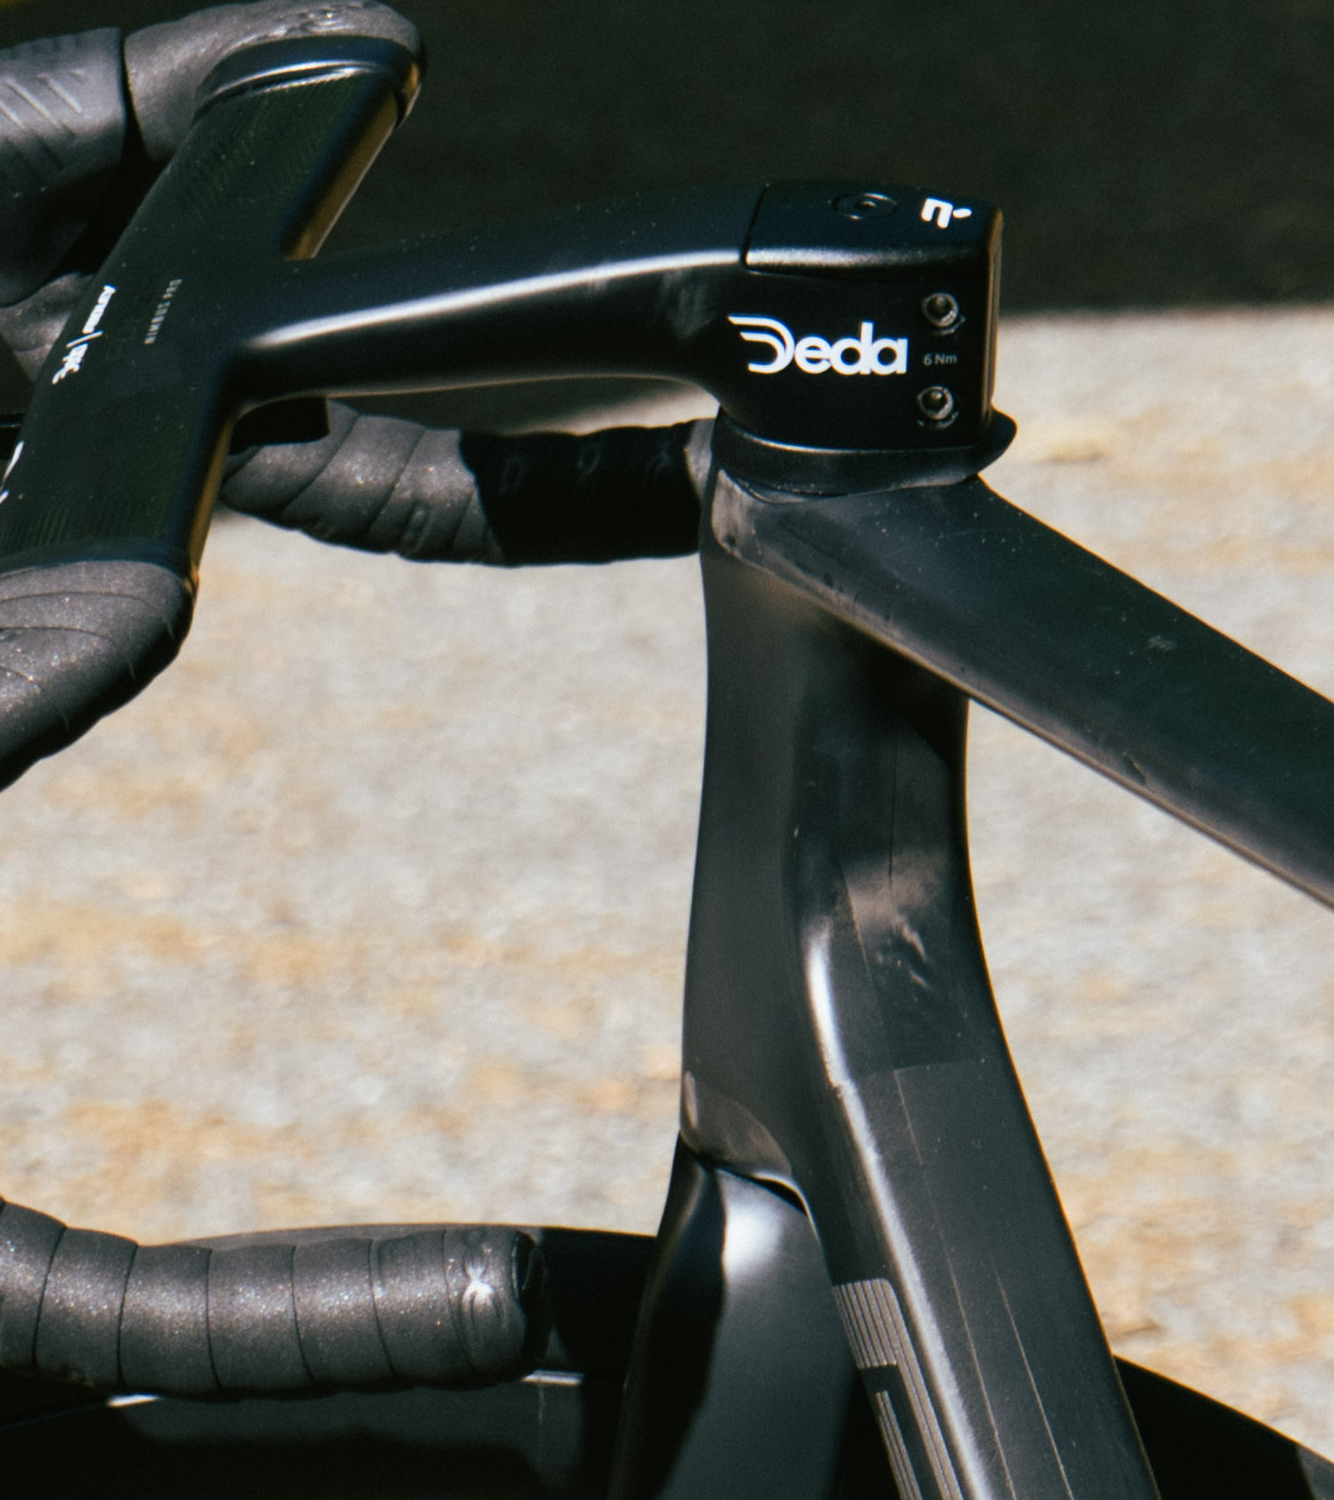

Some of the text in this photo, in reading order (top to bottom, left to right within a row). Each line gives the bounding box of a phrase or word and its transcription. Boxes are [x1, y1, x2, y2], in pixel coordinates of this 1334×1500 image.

[727, 312, 908, 376] Deda
[923, 352, 958, 366] 6 Nm
